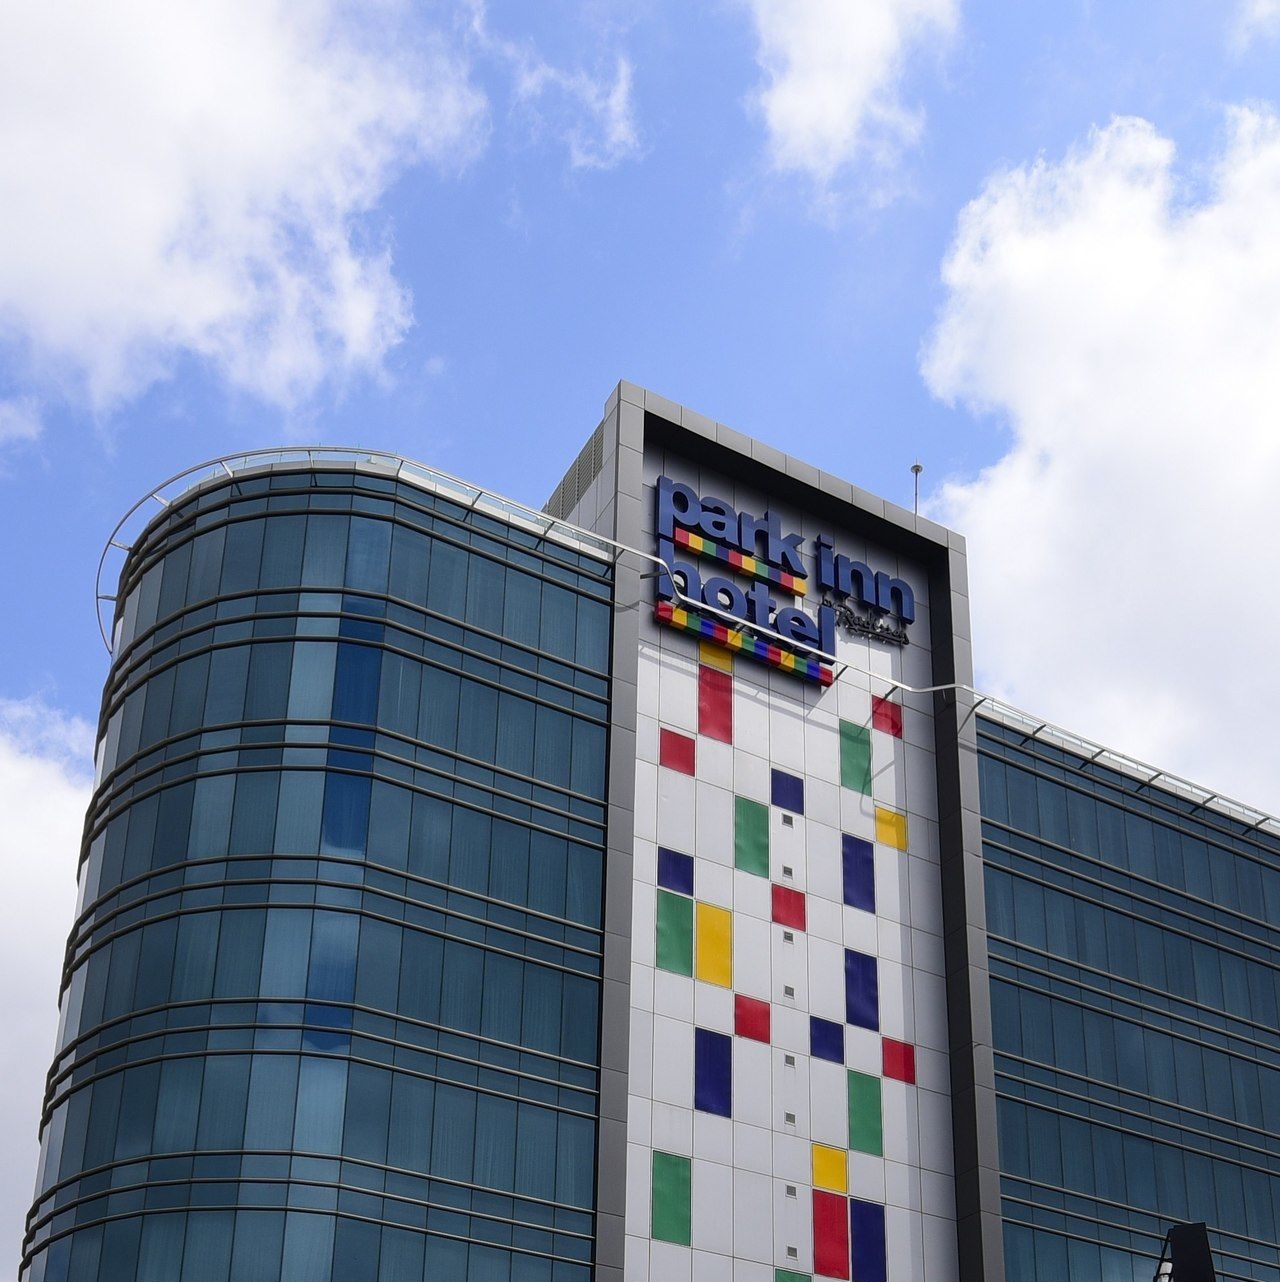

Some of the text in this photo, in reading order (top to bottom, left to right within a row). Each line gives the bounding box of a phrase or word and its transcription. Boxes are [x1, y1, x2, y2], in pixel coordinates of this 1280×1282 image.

[656, 475, 915, 625] park inn
[656, 538, 836, 666] hotel
